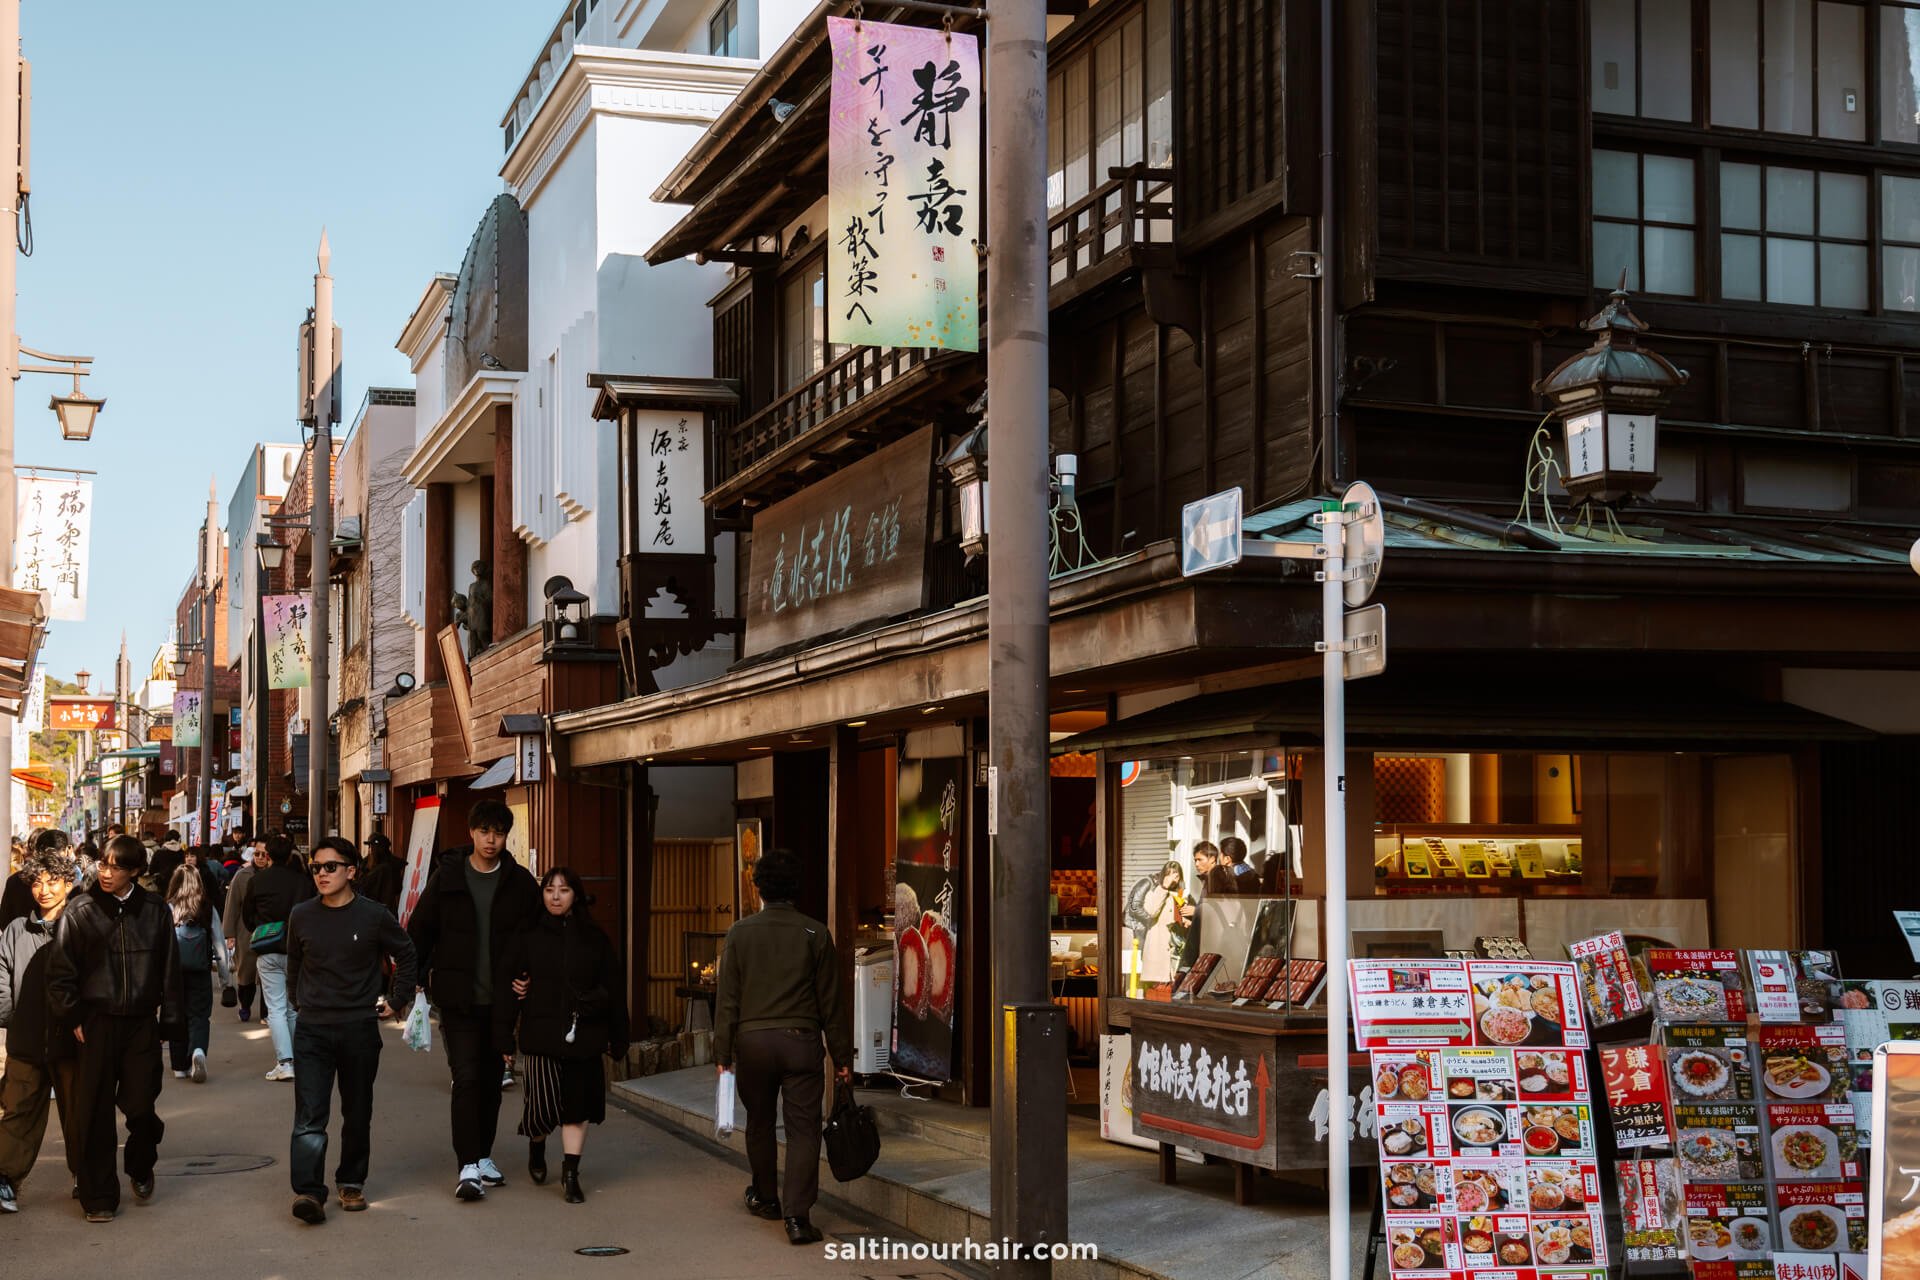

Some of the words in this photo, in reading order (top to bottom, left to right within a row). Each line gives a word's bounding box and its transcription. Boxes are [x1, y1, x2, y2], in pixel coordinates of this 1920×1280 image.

[651, 428, 675, 546] 源吉兆庵
[1573, 934, 1621, 956] 本日入荷
[1595, 952, 1624, 1020] 生しらす
[1412, 995, 1466, 1009] 鎌倉美水
[1687, 1038, 1702, 1046] TKG
[1765, 1038, 1817, 1046] ランチプレート
[1625, 1047, 1651, 1091] 鎌倉
[1603, 1049, 1628, 1106] ランチ
[1613, 1103, 1662, 1115] ミシュラン
[1776, 1116, 1820, 1124] サラダパスタ
[1616, 1126, 1665, 1139] 出身シェフ
[1641, 1161, 1657, 1196] 鎌倉産
[1619, 1161, 1641, 1230] 生しらす
[1790, 1195, 1833, 1203] サラダパスタ
[1627, 1247, 1676, 1260] 鎌倉地酒
[1777, 1263, 1836, 1280] 徒歩40秒
